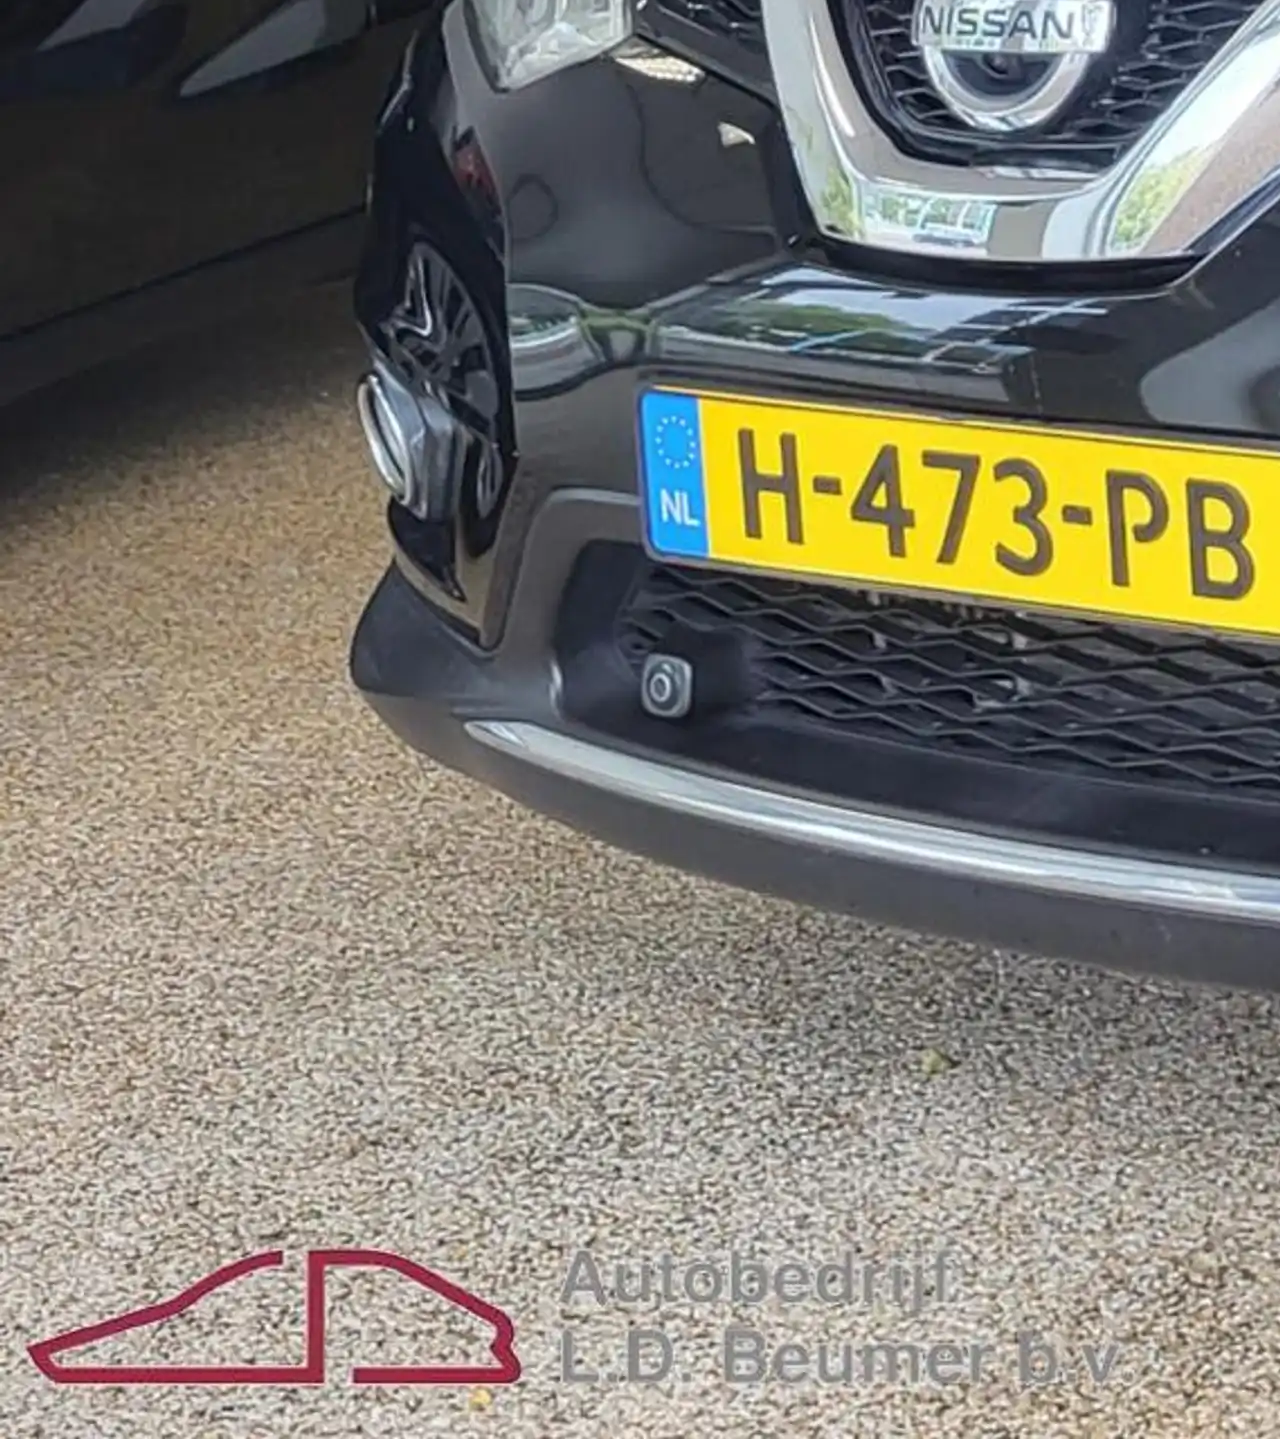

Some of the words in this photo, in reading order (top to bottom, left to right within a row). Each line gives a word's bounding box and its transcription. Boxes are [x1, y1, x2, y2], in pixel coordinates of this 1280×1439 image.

[920, 5, 1076, 40] NISSAN
[660, 489, 701, 528] NL
[736, 426, 1256, 602] H-473-PB
